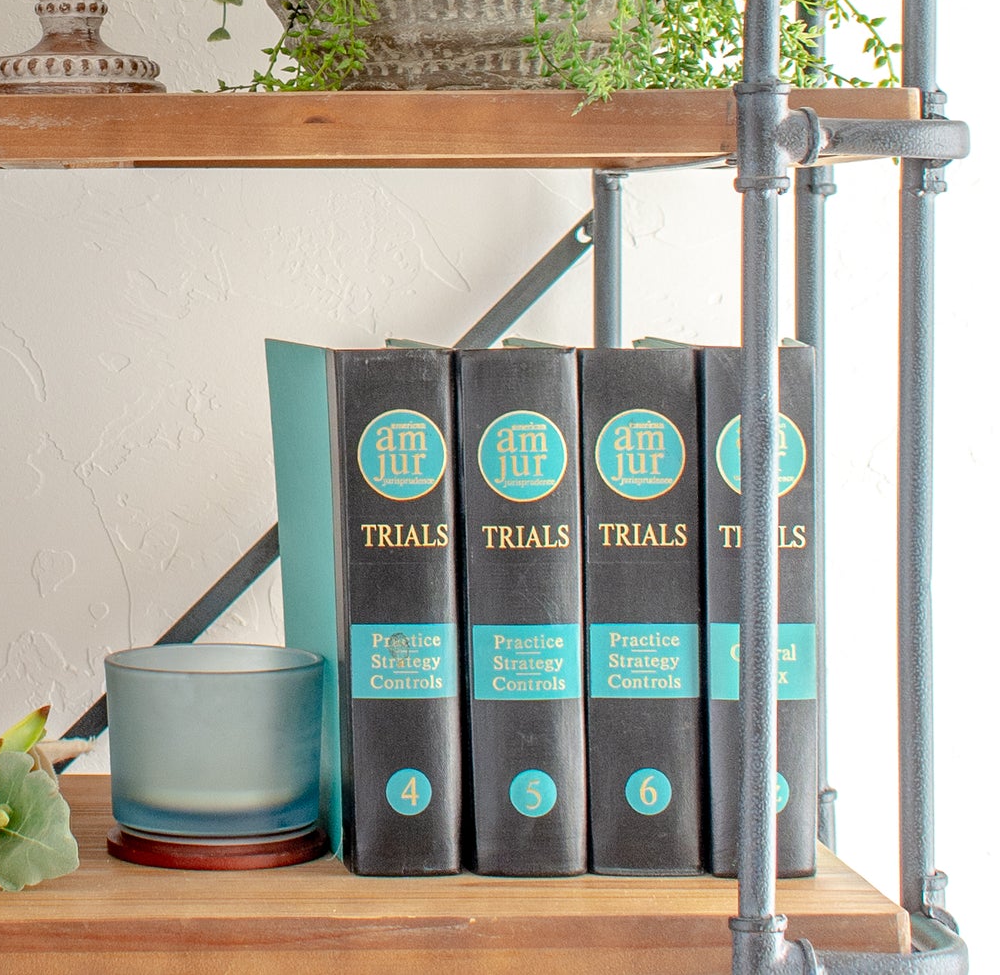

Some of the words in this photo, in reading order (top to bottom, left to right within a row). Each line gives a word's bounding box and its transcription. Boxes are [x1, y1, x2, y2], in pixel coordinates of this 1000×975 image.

[376, 426, 428, 452] am
[496, 428, 548, 453] am
[614, 426, 665, 451] am
[373, 453, 426, 482] jur
[494, 454, 547, 484] jur
[611, 452, 664, 481] jur
[361, 524, 449, 548] TRIALS
[482, 524, 570, 549] TRIALS
[599, 523, 687, 548] TRIALS
[494, 634, 564, 649] Practice
[609, 632, 680, 647] Practice
[371, 654, 441, 671] Strategy
[493, 655, 563, 673] Strategy
[608, 653, 679, 671] Strategy
[370, 674, 443, 690] Controls
[492, 675, 566, 691] Controls
[607, 674, 682, 689] Controls
[401, 777, 419, 807] 4
[526, 779, 542, 810] 5
[639, 776, 657, 806] 6
